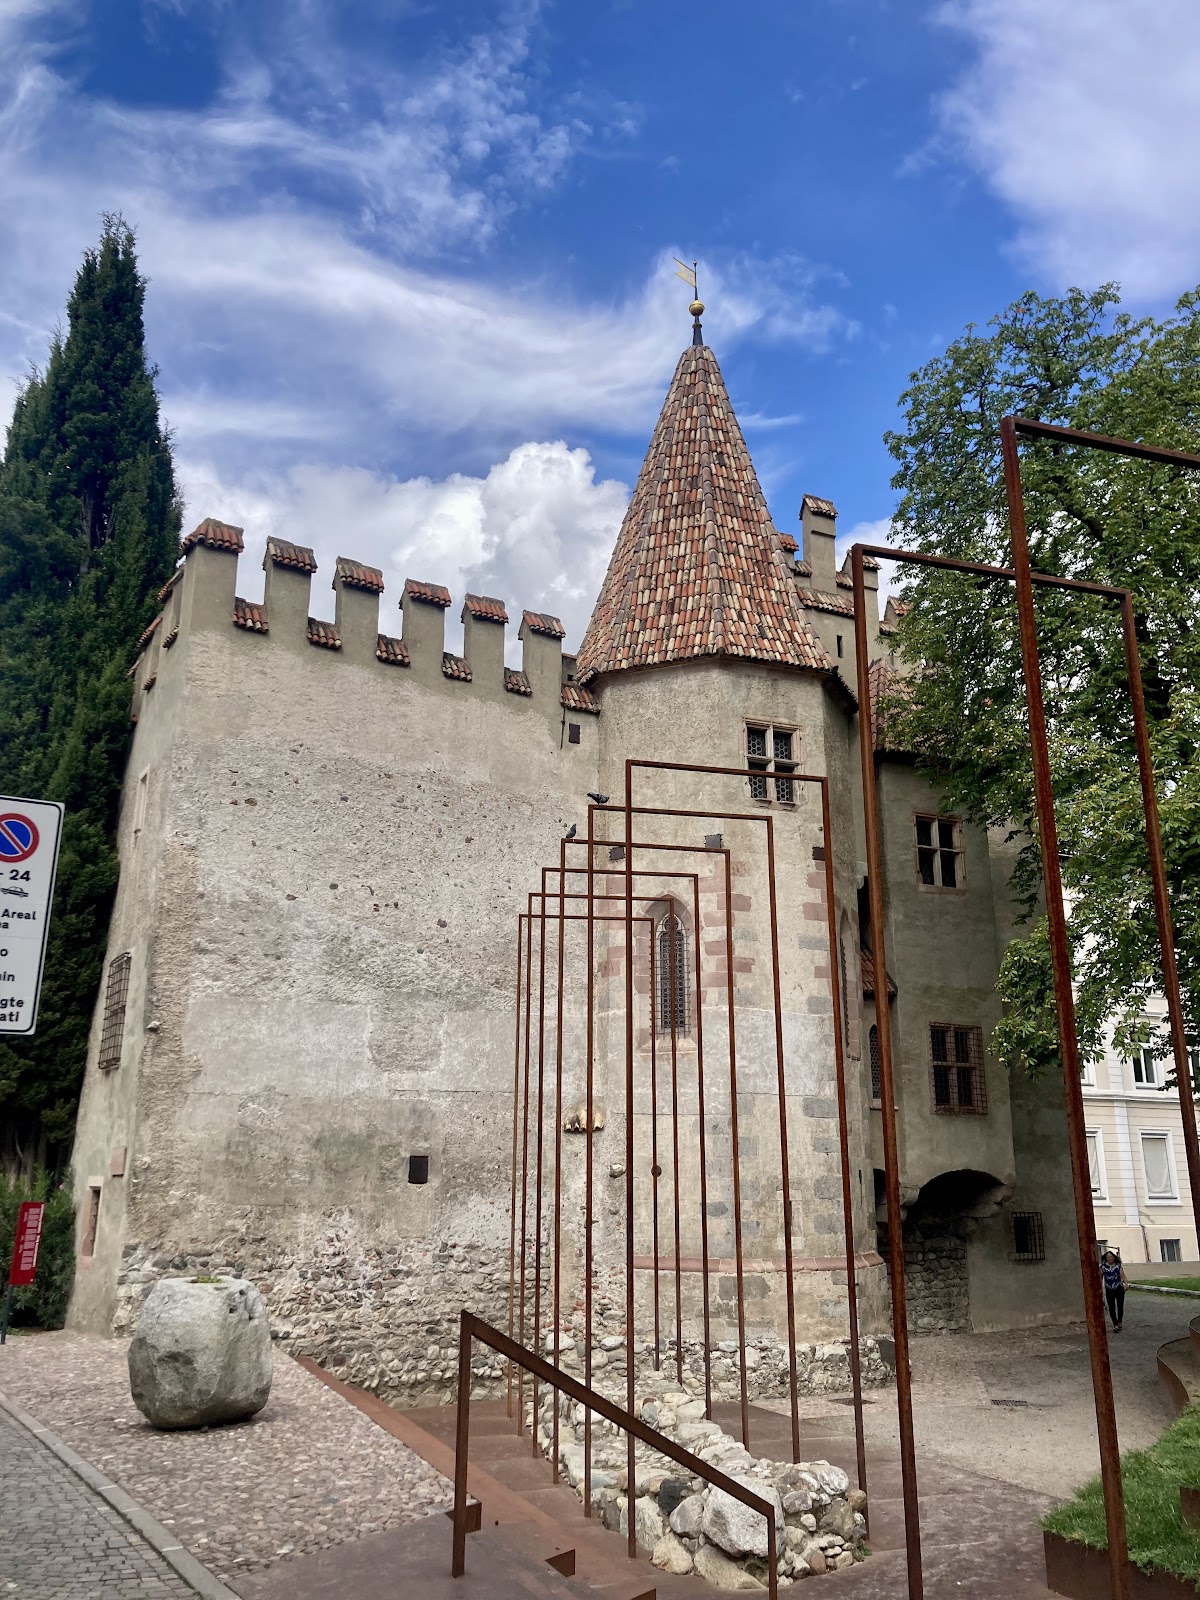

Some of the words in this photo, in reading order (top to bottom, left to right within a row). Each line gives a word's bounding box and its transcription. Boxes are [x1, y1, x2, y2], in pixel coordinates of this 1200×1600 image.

[9, 869, 31, 882] 24
[1, 908, 36, 920] Areal
[0, 996, 24, 1009] gte
[0, 1011, 19, 1022] ati
